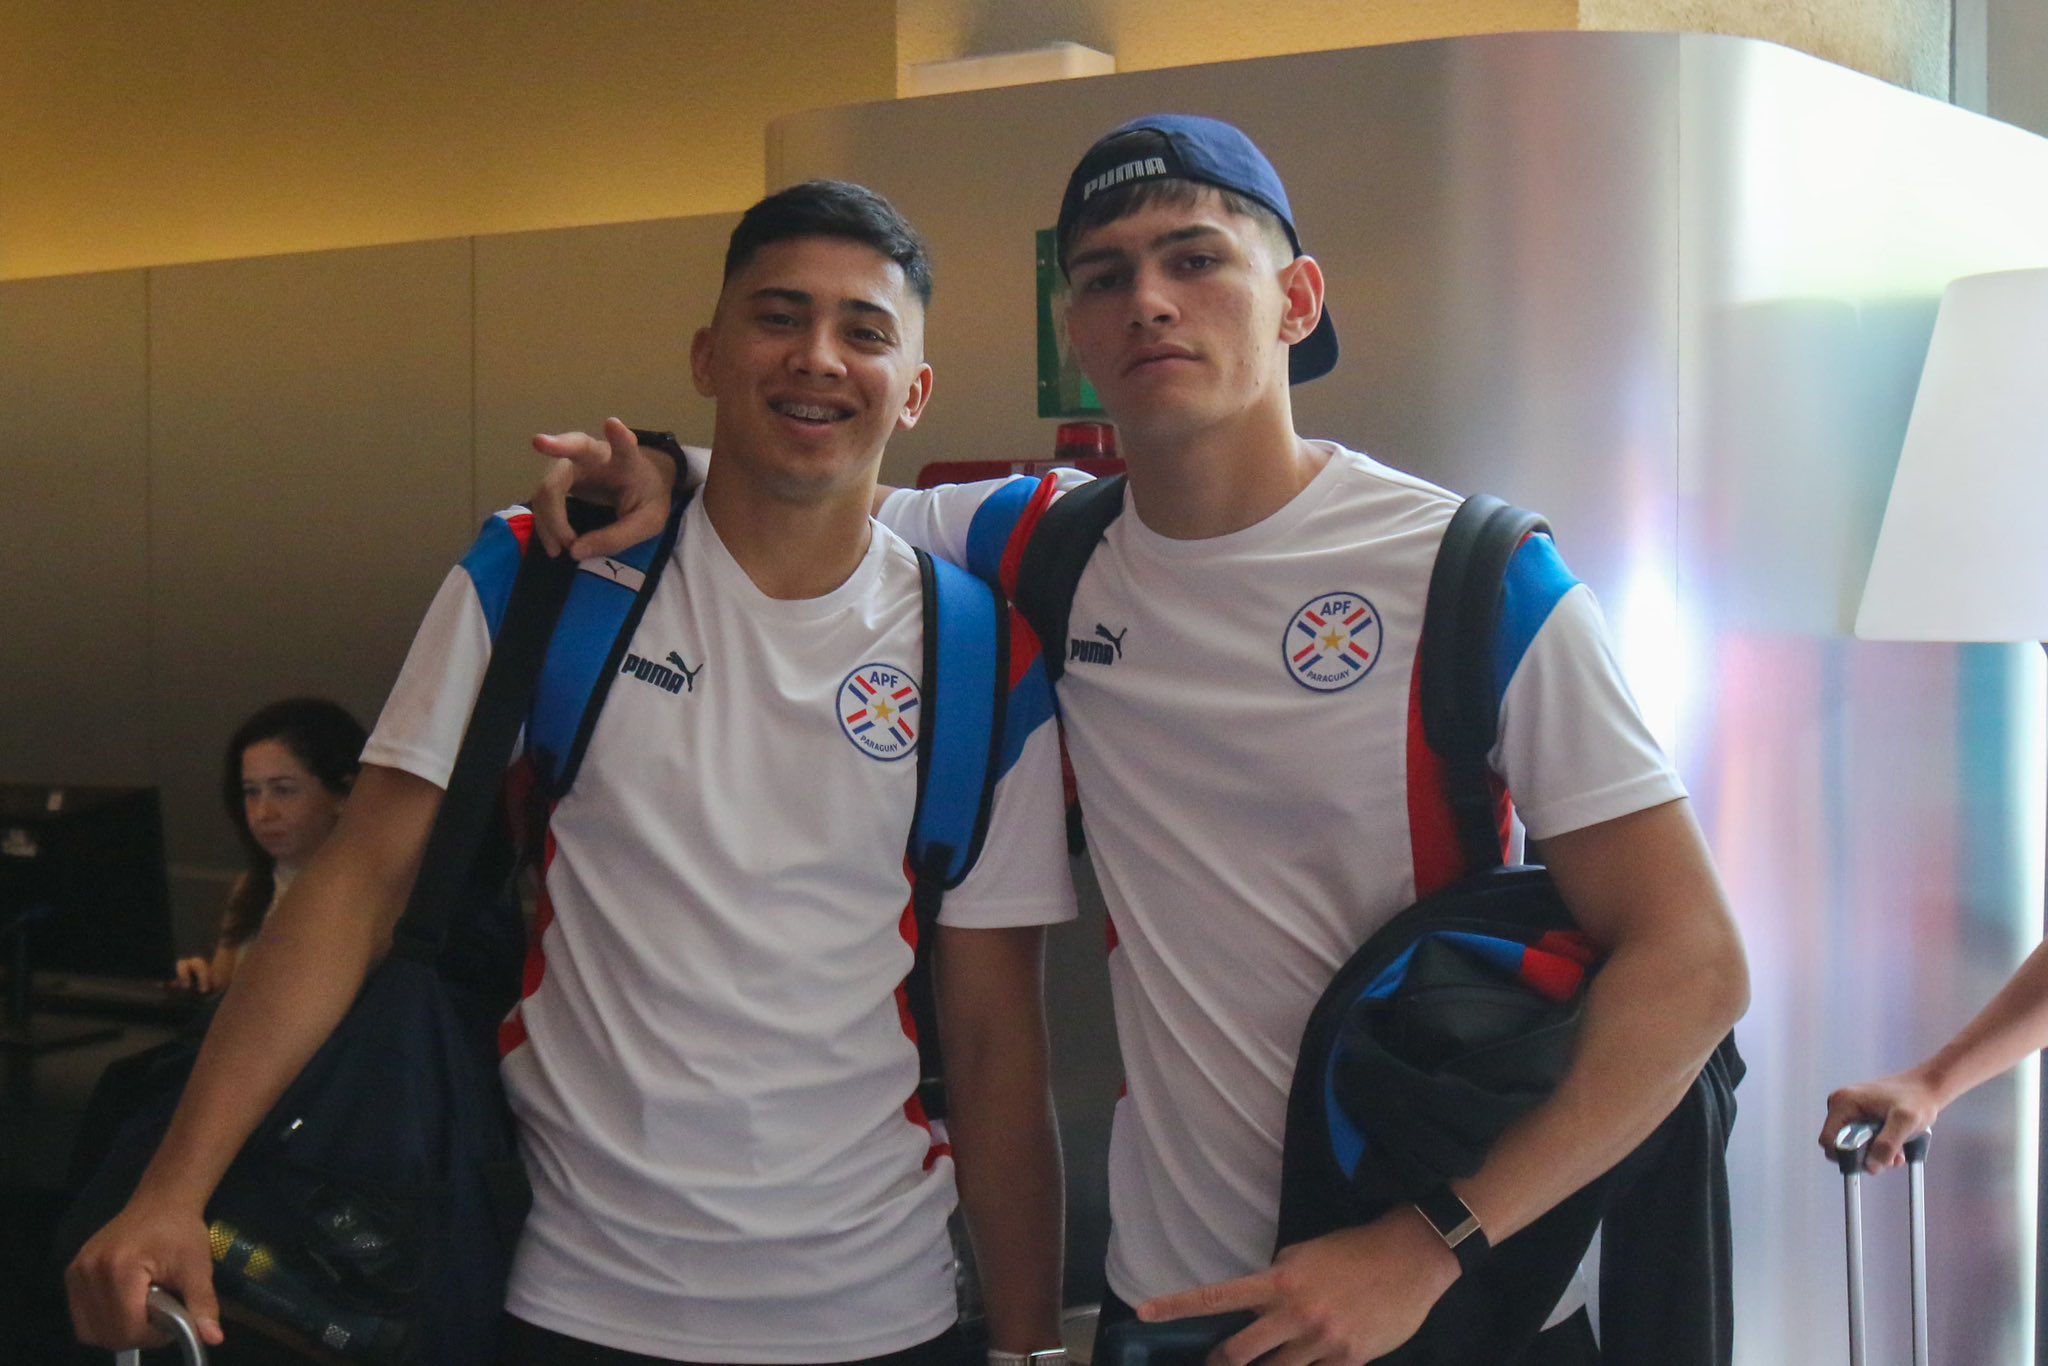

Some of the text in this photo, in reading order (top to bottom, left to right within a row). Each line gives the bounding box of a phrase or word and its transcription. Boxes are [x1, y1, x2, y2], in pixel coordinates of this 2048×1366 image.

[1083, 157, 1167, 200] PUMA
[1320, 601, 1352, 616] APF
[1070, 639, 1114, 666] PUMA
[621, 653, 686, 694] PUMA
[869, 671, 899, 688] APF
[1306, 669, 1350, 682] PARAGUAY
[860, 735, 898, 752] PARAGUAY
